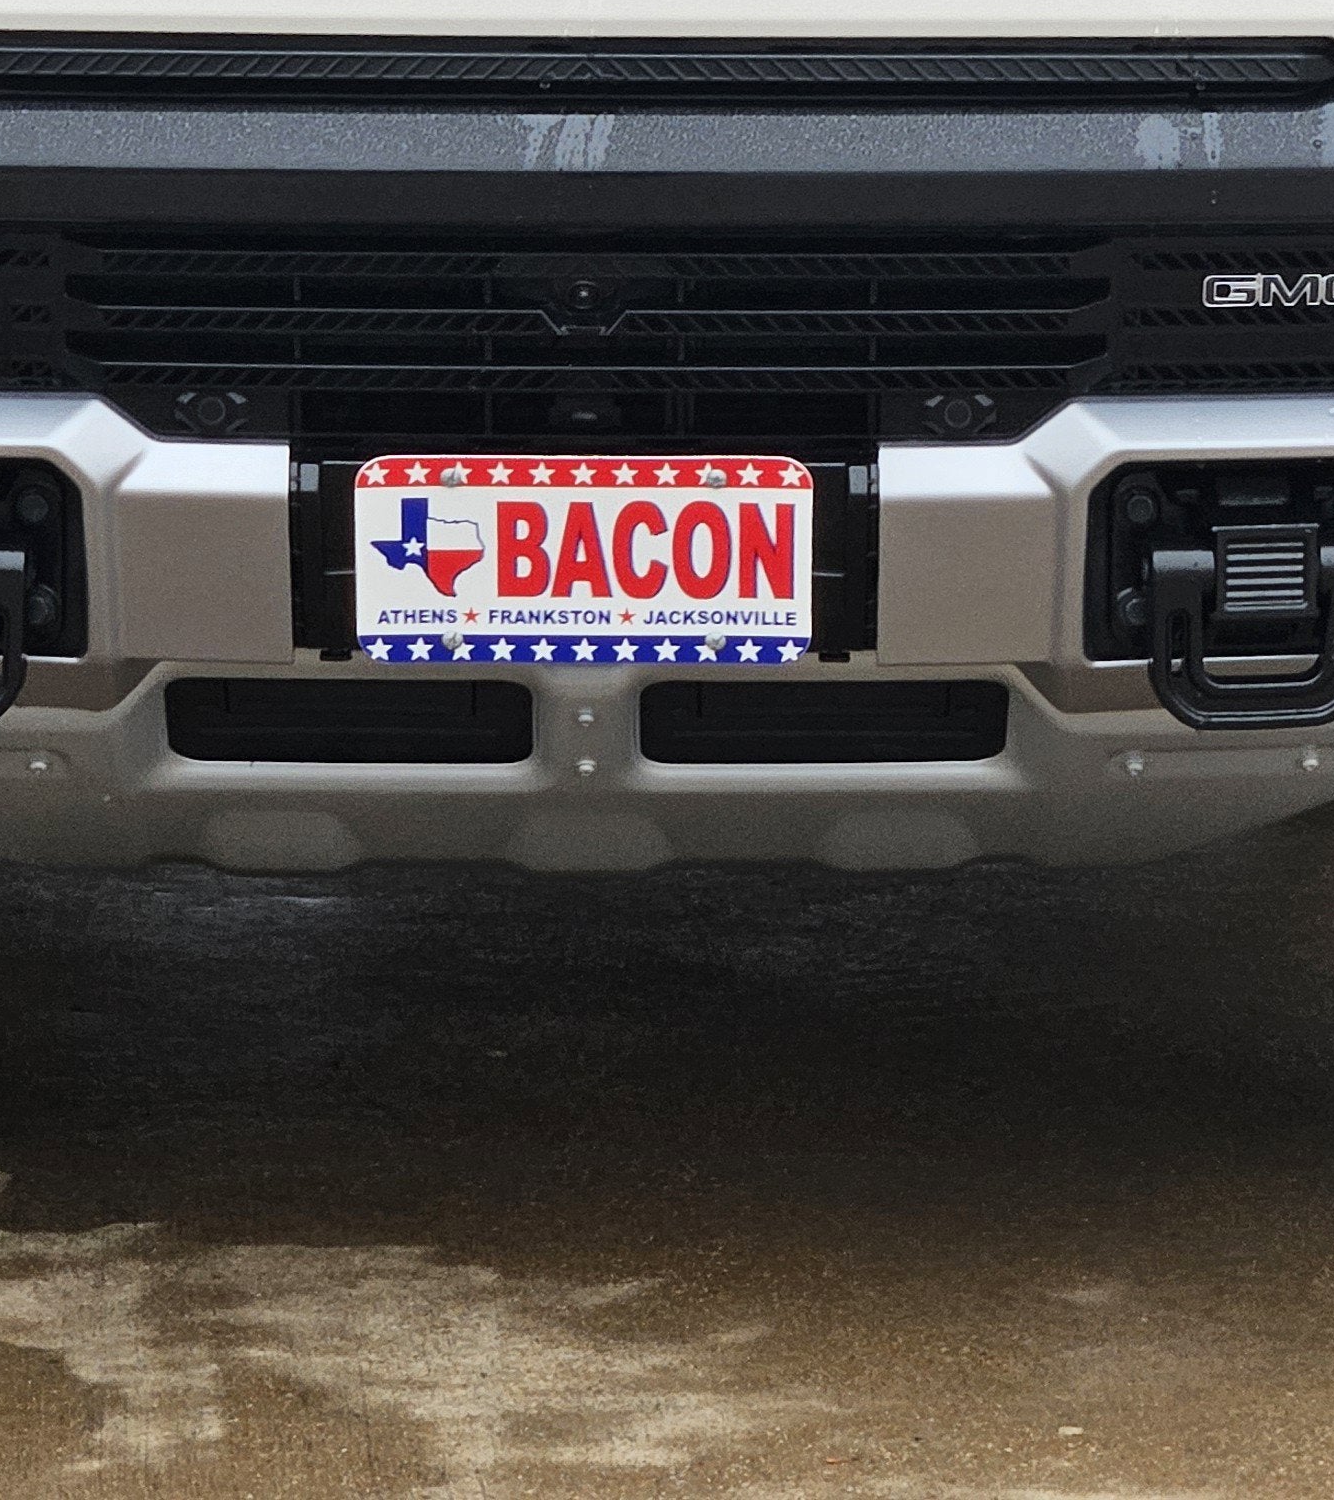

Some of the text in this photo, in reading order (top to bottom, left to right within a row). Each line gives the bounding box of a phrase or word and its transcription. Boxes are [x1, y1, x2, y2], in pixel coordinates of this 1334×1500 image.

[496, 500, 795, 599] BACON
[377, 608, 797, 627] ATHENS FRANKSTON JACKSONVILLE
